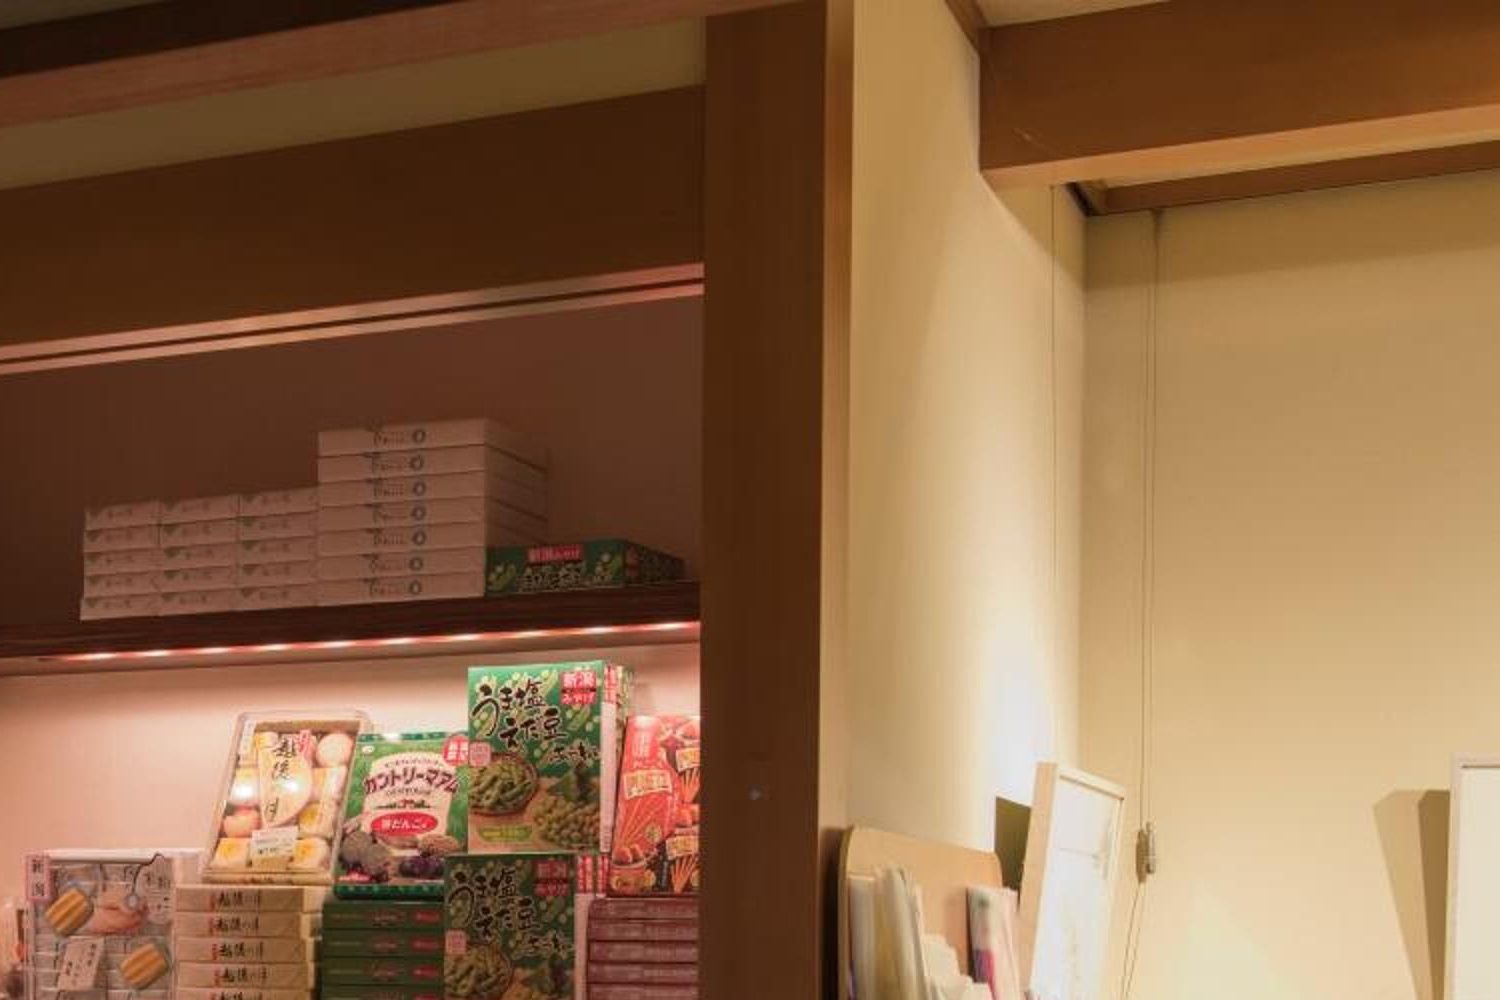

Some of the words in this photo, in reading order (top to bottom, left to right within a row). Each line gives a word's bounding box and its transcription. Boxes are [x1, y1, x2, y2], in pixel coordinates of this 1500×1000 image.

[364, 766, 458, 794] カントリーマアム
